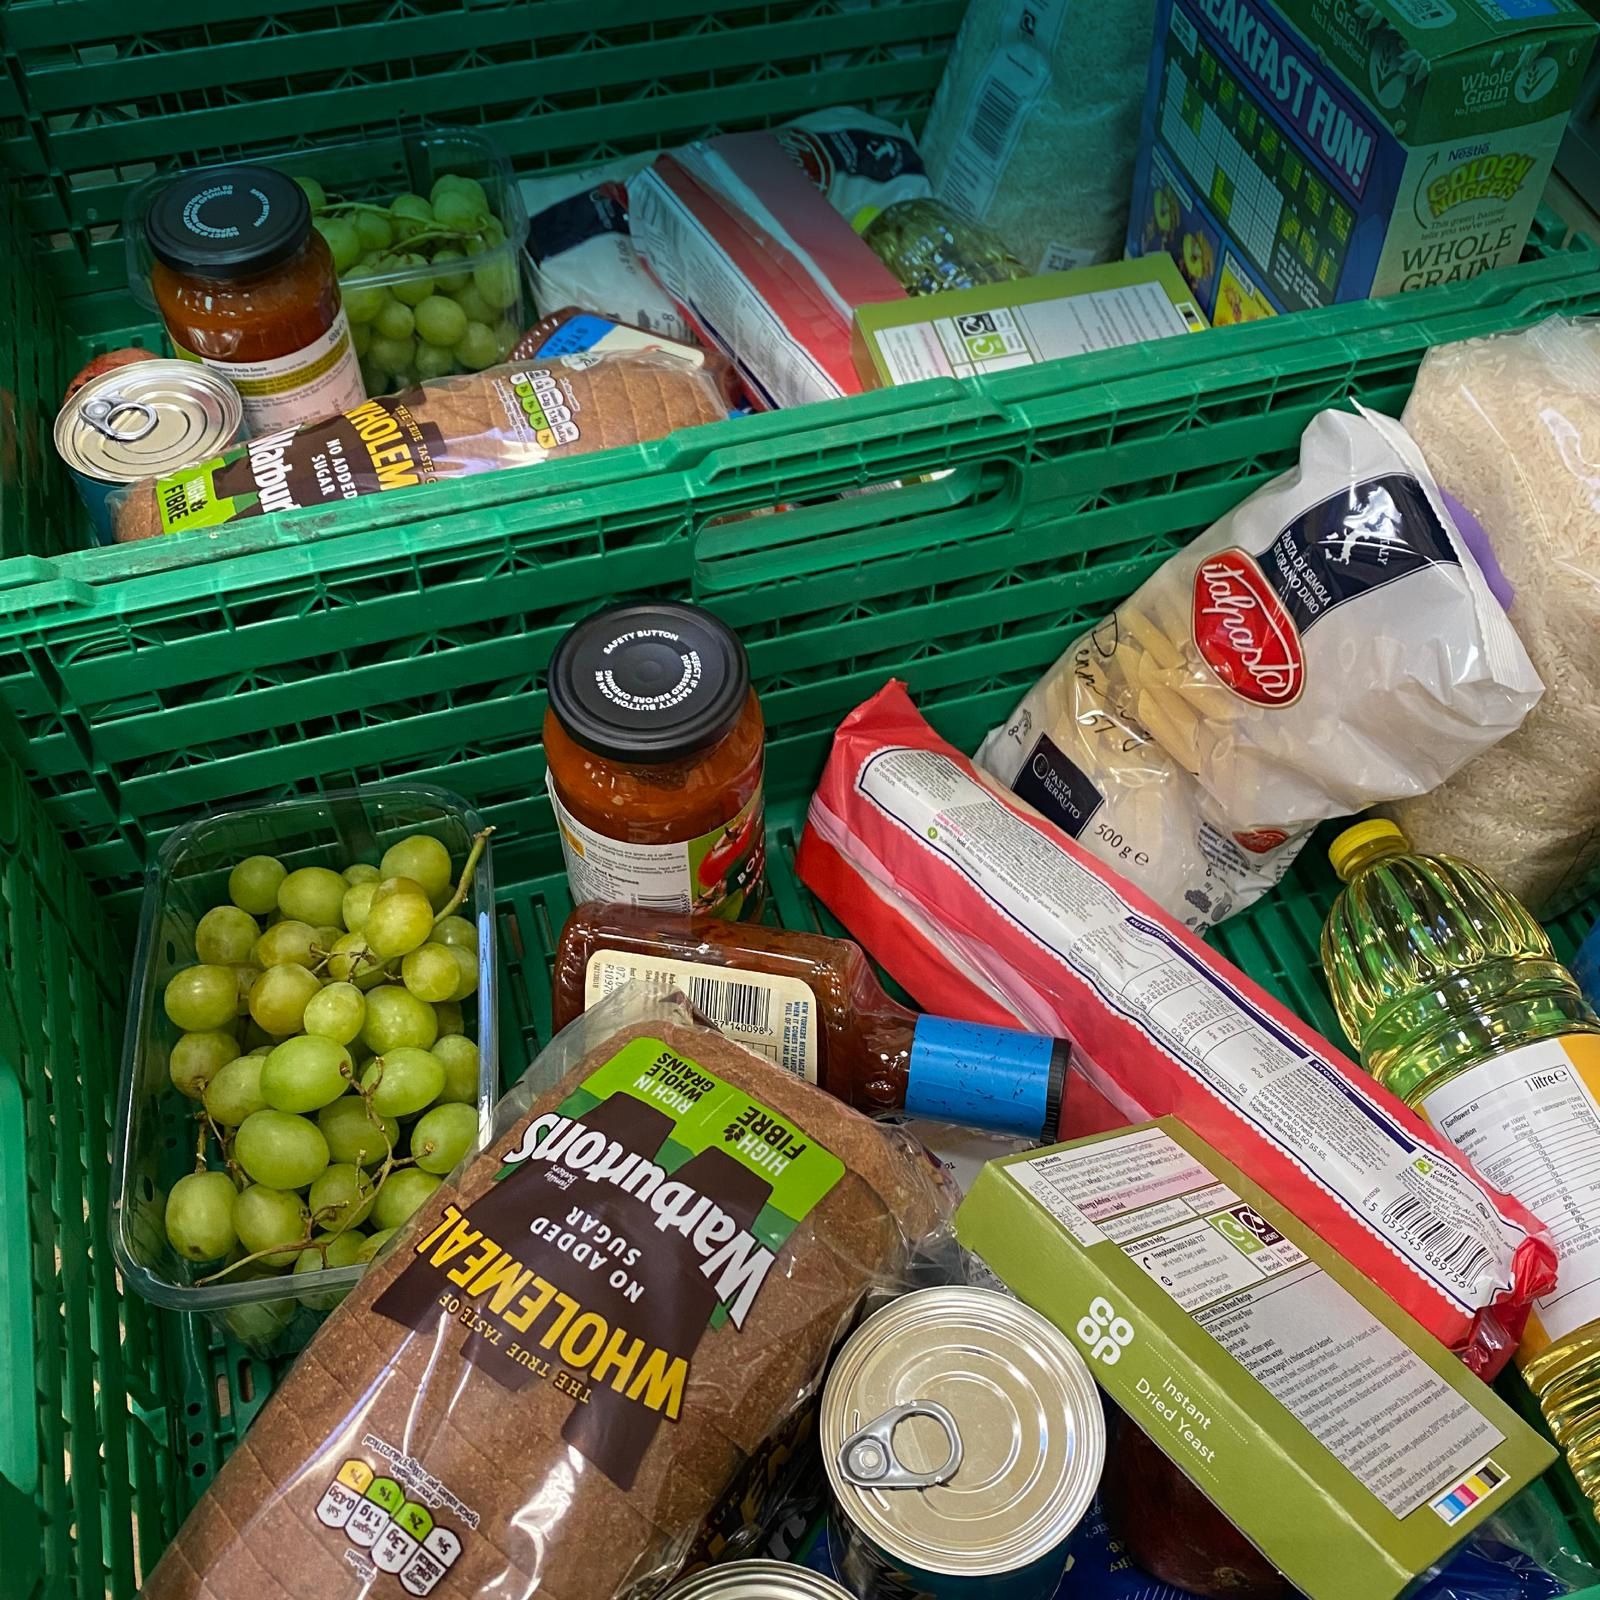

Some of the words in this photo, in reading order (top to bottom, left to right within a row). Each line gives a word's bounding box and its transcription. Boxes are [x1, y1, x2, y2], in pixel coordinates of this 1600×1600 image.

[1200, 0, 1314, 118] EAKFAST
[1308, 85, 1371, 187] FUN!
[1461, 67, 1514, 92] Whole
[1463, 85, 1509, 107] Grain
[1401, 223, 1518, 273] WHOLE
[1400, 253, 1501, 293] GRAIN
[326, 438, 344, 455] NO
[344, 400, 421, 491] WHOLEM
[395, 403, 412, 424] THE
[405, 420, 424, 443] TRUE
[416, 444, 435, 473] TASTE
[247, 425, 303, 514] Warbur
[311, 453, 335, 496] SUGAR
[331, 453, 358, 500] ADDED
[164, 484, 190, 525] FIBRE
[1378, 537, 1390, 565] TALY
[1276, 529, 1304, 559] PASTA
[1292, 555, 1308, 571] DI
[1301, 567, 1333, 607] SEMOLA
[1272, 552, 1303, 590] GRANO
[1295, 585, 1321, 615] DURO
[603, 632, 636, 655] SAFETY
[637, 629, 680, 643] BUTTON
[671, 654, 693, 696] DEPRESSED
[689, 650, 702, 680] REJECT
[604, 669, 632, 701] OPENING
[633, 692, 672, 704] BEFORE
[658, 687, 693, 711] SAFETY
[612, 697, 657, 711] BUTTON
[1049, 766, 1073, 799] PASTA
[1043, 777, 1081, 820] BERRUTO
[1095, 823, 1124, 850] 500
[1118, 844, 1133, 860] g
[973, 853, 985, 864] may
[995, 872, 1014, 888] peanuts
[1011, 885, 1021, 894] and
[1129, 918, 1169, 942] NUTRITION
[728, 1022, 766, 1036] 140098
[632, 1075, 653, 1091] IN
[643, 1061, 704, 1103] WHOLE
[656, 1051, 716, 1093] GRAINS
[1312, 1061, 1350, 1095] STORAGE
[1523, 1079, 1533, 1092] 1
[1531, 1071, 1555, 1090] litre
[653, 1086, 695, 1115] RICH
[1237, 1081, 1249, 1093] 6g
[1247, 1101, 1275, 1125] Mon-Sat,
[1250, 1094, 1285, 1124] Freephone
[1281, 1119, 1301, 1138] 0800
[1299, 1134, 1310, 1145] 50
[1307, 1142, 1319, 1153] 55
[1256, 1089, 1270, 1102] We
[1267, 1098, 1280, 1110] are
[1277, 1106, 1293, 1121] here
[1290, 1118, 1300, 1127] to
[1297, 1123, 1315, 1140] help.
[1262, 1086, 1297, 1116] information
[1294, 1113, 1314, 1131] please
[1313, 1129, 1326, 1141] visit
[1444, 1106, 1469, 1129] Sunflower
[1469, 1103, 1480, 1115] Oil
[736, 1105, 808, 1162] FIBRE
[1454, 1126, 1478, 1145] Nutrition
[735, 1132, 792, 1177] HIGH
[1422, 1153, 1457, 1177] Recycling
[1429, 1173, 1449, 1186] Widely
[1433, 1168, 1459, 1186] CARTON
[502, 1112, 776, 1332] Warburtons
[565, 1205, 643, 1266] SUGAR
[529, 1215, 609, 1272] ADDED
[1122, 1243, 1140, 1253] We're
[1135, 1240, 1150, 1249] here
[1149, 1245, 1178, 1260] Freephone
[1367, 1201, 1378, 1213] 5
[1380, 1212, 1424, 1252] 057545
[1423, 1250, 1469, 1290] 889756
[609, 1271, 645, 1303] NO
[416, 1205, 689, 1420] WHOLEMEAL
[438, 1291, 463, 1314] OF
[1193, 1309, 1214, 1322] Classic
[1208, 1304, 1227, 1315] White
[1221, 1298, 1239, 1310] Bread
[1234, 1292, 1255, 1305] Recipe
[459, 1307, 504, 1347] TASTE
[1216, 1317, 1233, 1328] white
[1227, 1311, 1245, 1322] bread
[1239, 1307, 1255, 1317] flour
[1223, 1327, 1241, 1338] butter
[1224, 1341, 1242, 1353] pinch
[1235, 1337, 1249, 1346] salt
[505, 1345, 552, 1379] TRUE
[1239, 1349, 1254, 1359] fast
[1247, 1343, 1265, 1355] action
[1259, 1338, 1277, 1350] yeast
[1253, 1370, 1267, 1381] add
[1271, 1360, 1289, 1373] sugar
[1288, 1349, 1307, 1362] thicker
[1302, 1345, 1317, 1355] crust
[1258, 1354, 1274, 1364] warm
[1269, 1348, 1285, 1358] water
[554, 1371, 594, 1404] THE
[1162, 1376, 1212, 1431] Instant
[1135, 1378, 1177, 1422] Dried
[1176, 1417, 1216, 1463] Yeast
[346, 1466, 364, 1484] 7%
[326, 1484, 357, 1511] 0.43g
[375, 1484, 393, 1503] 1%
[433, 1486, 460, 1509] values
[324, 1502, 342, 1518] Salt
[356, 1503, 385, 1528] 1.1g
[404, 1510, 425, 1530] 2%
[452, 1503, 481, 1528] Typical
[349, 1517, 376, 1540] Sugars
[382, 1527, 413, 1556] 1.3g
[380, 1547, 396, 1563] Fat
[432, 1535, 453, 1556] 5%
